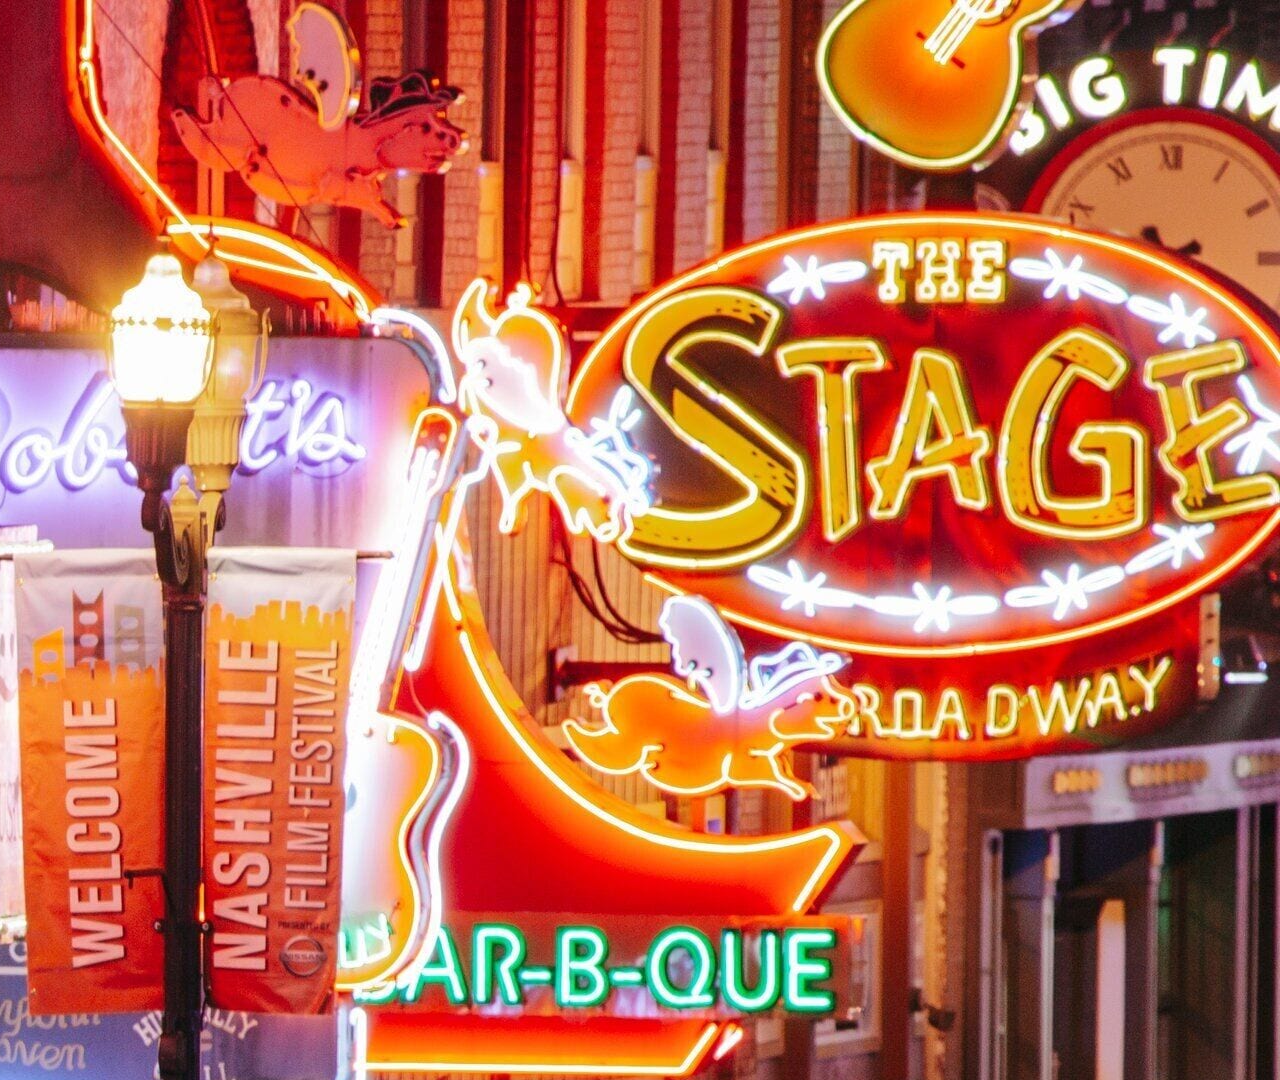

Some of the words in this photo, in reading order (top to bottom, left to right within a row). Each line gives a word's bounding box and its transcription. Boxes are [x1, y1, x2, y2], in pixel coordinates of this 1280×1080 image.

[872, 239, 1006, 303] THE
[620, 286, 1280, 569] STAGE
[288, 640, 338, 808] FESTIVAL
[849, 657, 1172, 739] ROADWAY
[64, 697, 125, 969] WELCOME
[213, 640, 279, 971] NASHVILLE
[284, 818, 330, 909] FILM
[133, 1006, 258, 1047] HIILLY
